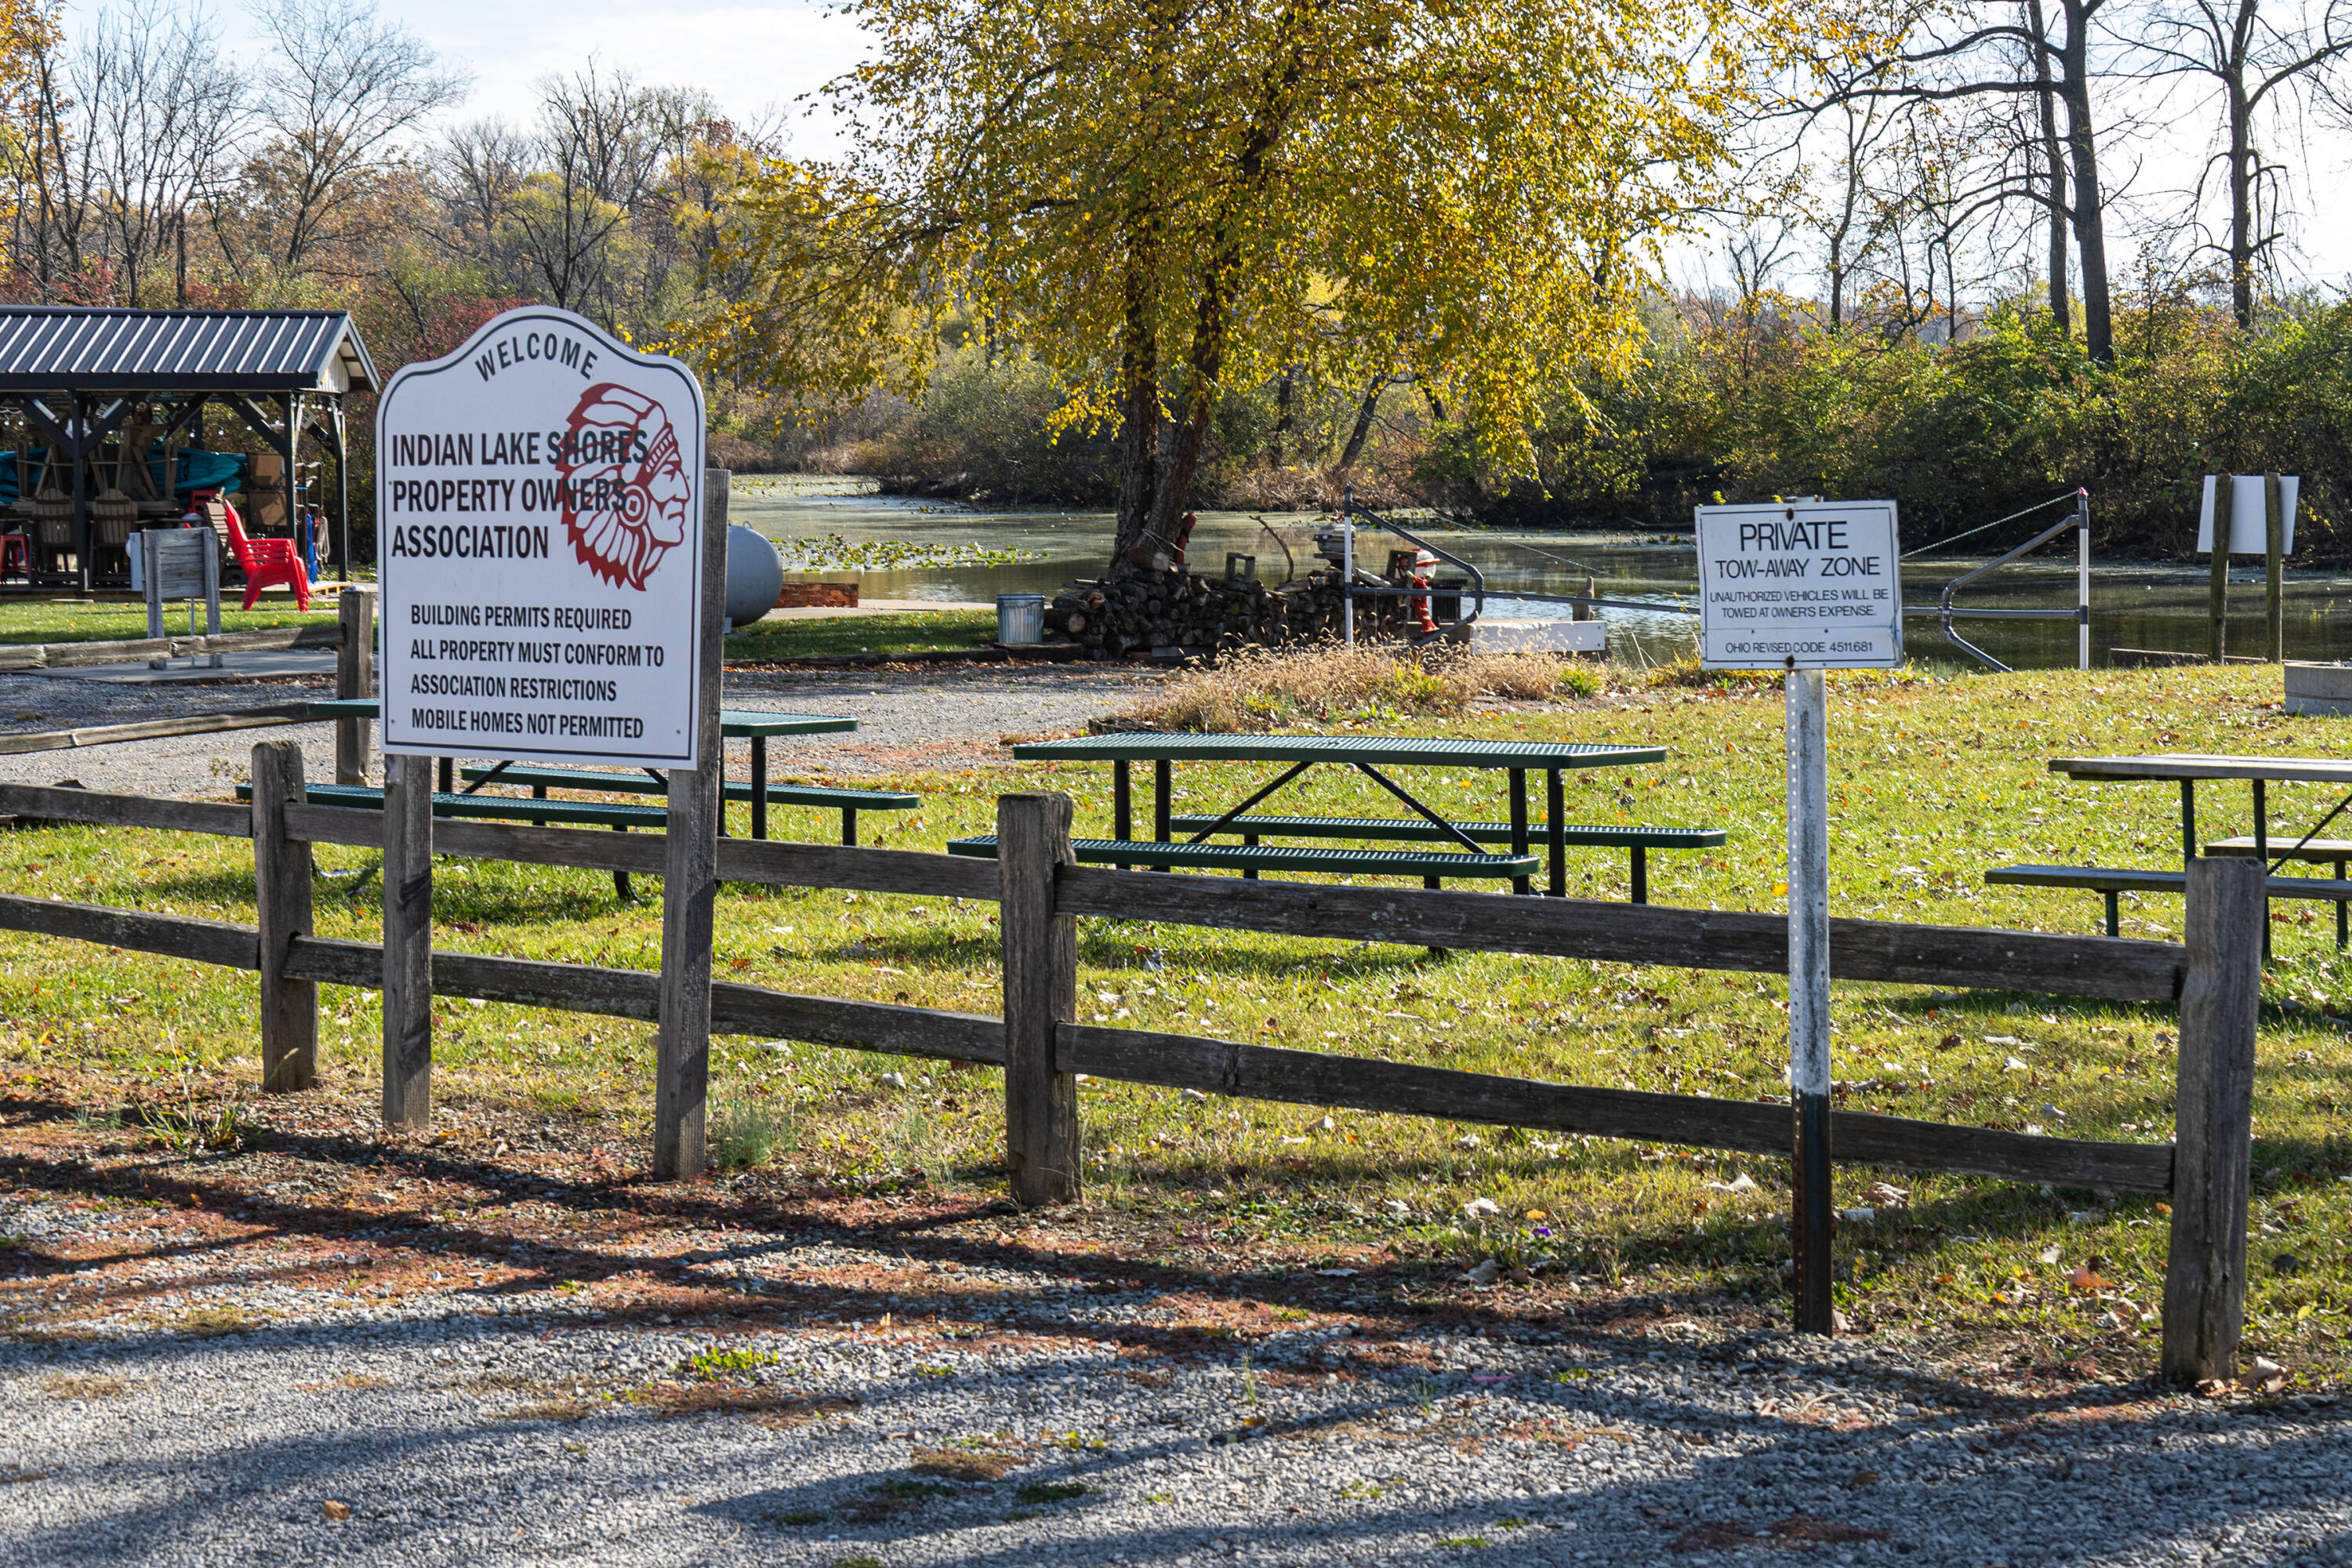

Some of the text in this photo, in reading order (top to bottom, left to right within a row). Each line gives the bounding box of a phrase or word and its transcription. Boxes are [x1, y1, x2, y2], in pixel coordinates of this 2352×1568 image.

[475, 332, 599, 382] WELCOME
[392, 430, 648, 466] INDIAN LAKE SHORES
[393, 478, 627, 512] PROPERTY OWNERS
[391, 524, 548, 558] ASSOCIATION
[1740, 521, 1849, 551] PRIVATE
[1715, 557, 1881, 579] TOW-AWAY ZONE
[1710, 589, 1888, 602] UNAUTHORIZED VEHICLES WILL BE
[411, 604, 632, 632] BUILDING PERMITS REQUIRED
[1722, 605, 1877, 618] TOWED AT OWNER'S EXPENSE.
[411, 639, 664, 666] ALL PROPERTY MUST CONFORM TO
[1726, 641, 1872, 653] OHIO REVISED CODE 4511.681
[411, 673, 616, 701] ASSOCIATION RESTRICTIONS
[412, 708, 643, 739] MOBILE HOMES NOT PERMITTED
